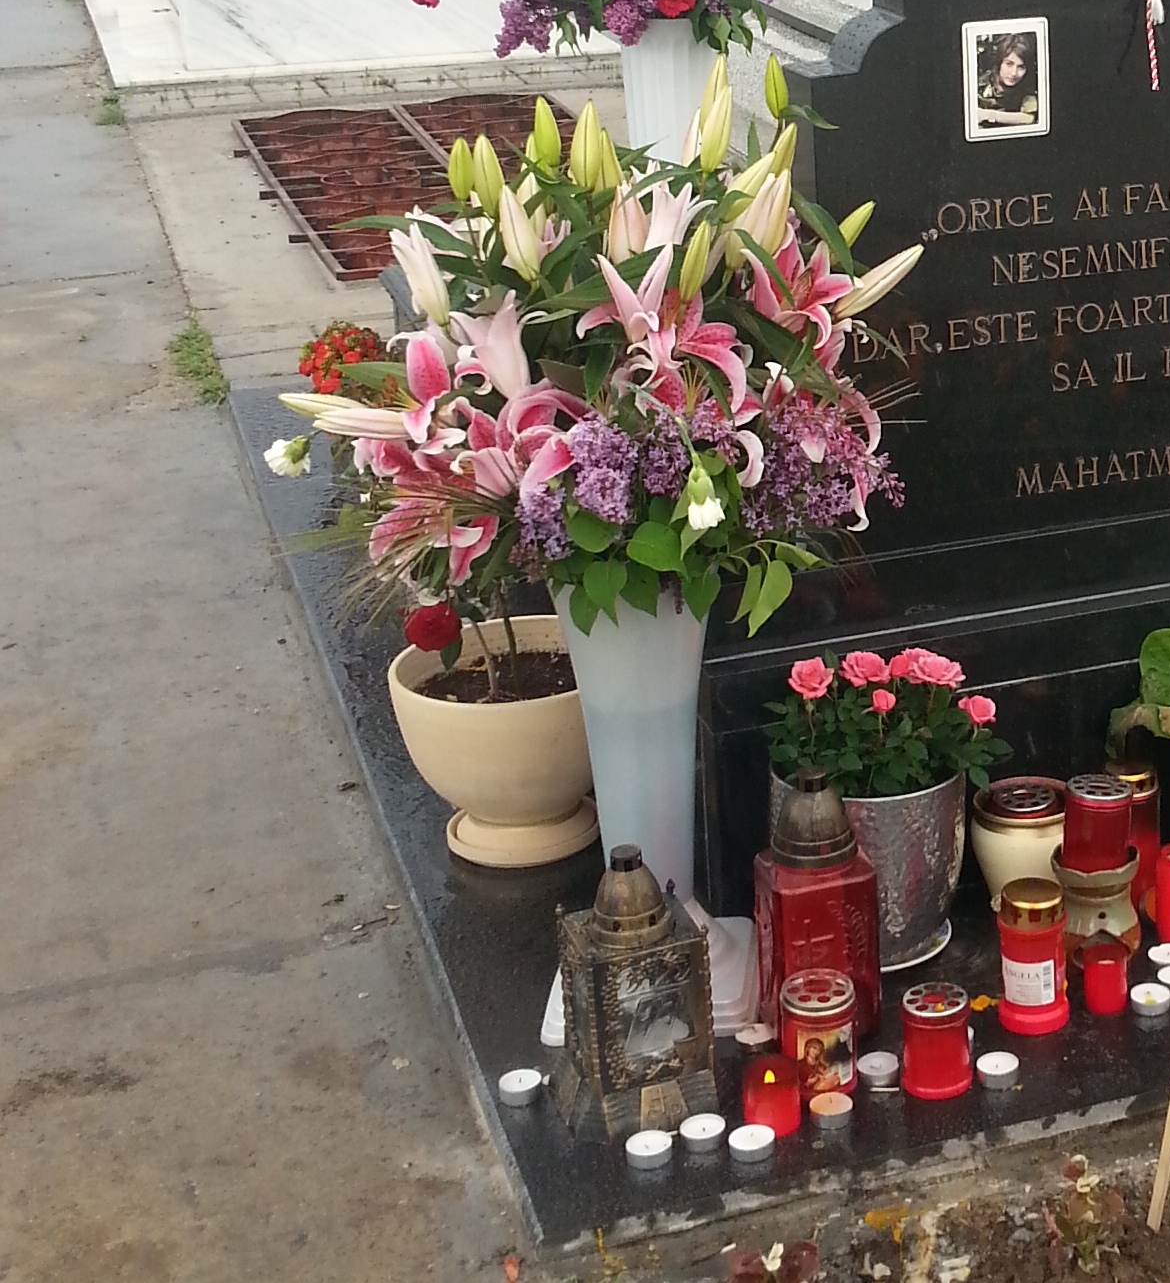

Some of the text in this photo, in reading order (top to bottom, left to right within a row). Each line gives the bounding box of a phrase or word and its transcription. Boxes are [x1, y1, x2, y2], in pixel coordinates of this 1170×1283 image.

[1073, 187, 1109, 220] AI
[1052, 359, 1097, 392] SA
[1112, 352, 1146, 383] IL
